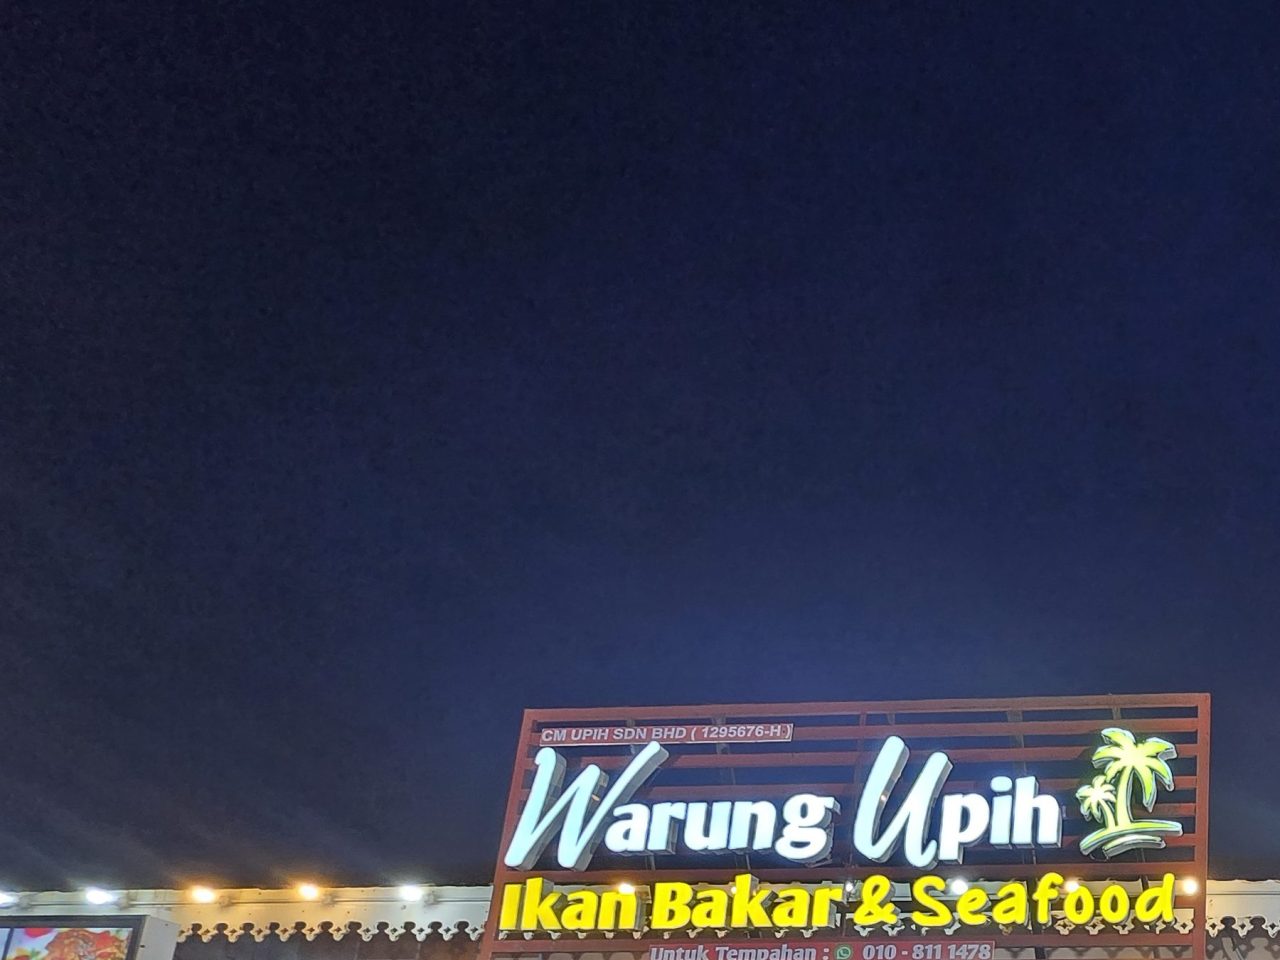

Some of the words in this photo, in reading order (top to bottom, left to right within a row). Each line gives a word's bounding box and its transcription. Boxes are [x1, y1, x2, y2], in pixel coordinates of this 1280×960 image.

[571, 728, 609, 741] UPIH
[612, 727, 648, 740] SDN
[651, 726, 687, 740] BHD
[503, 740, 838, 869] Warung
[853, 735, 1063, 868] Upih
[499, 876, 638, 931] Ikan
[650, 873, 844, 929] Bakar
[853, 873, 898, 927] &
[911, 872, 1176, 928] Seafood
[862, 944, 897, 960] 010
[911, 943, 942, 960] 811
[946, 943, 992, 960] 1478
